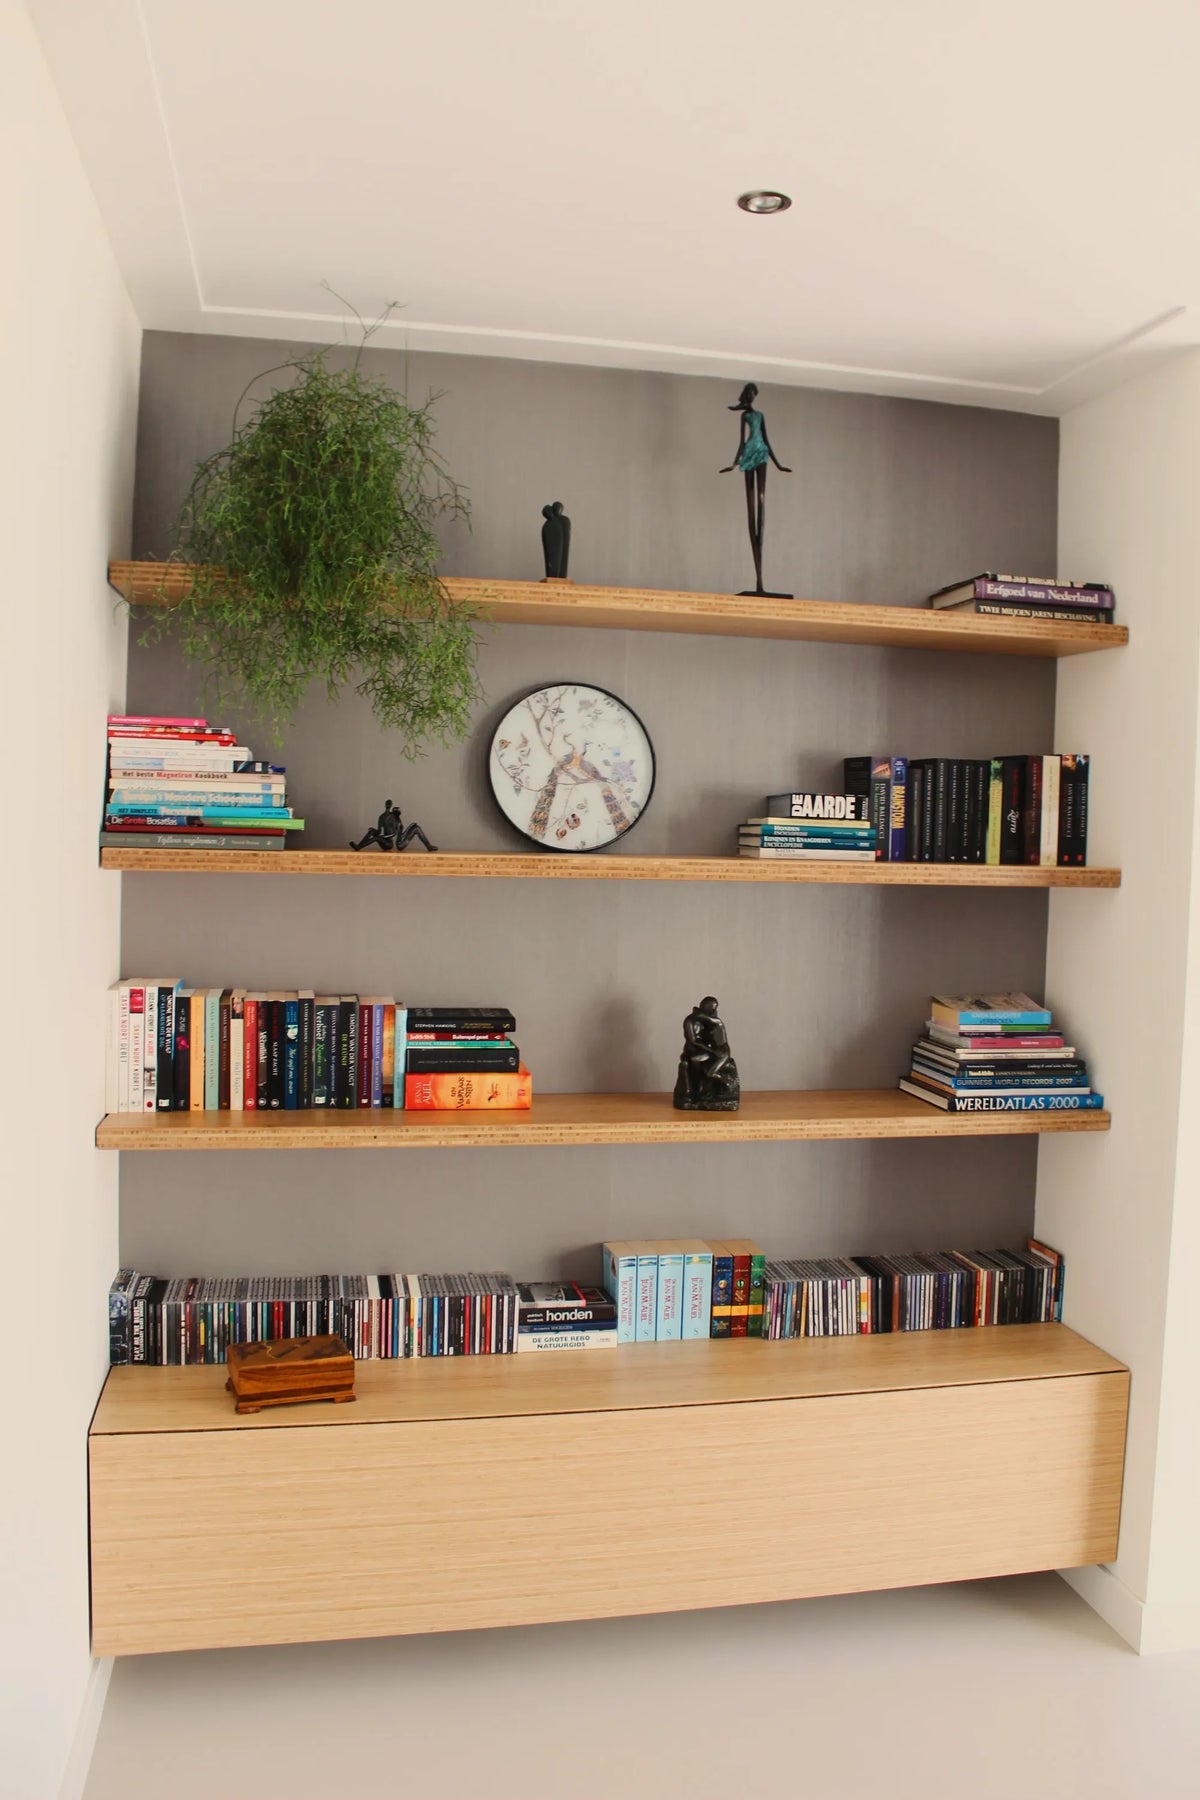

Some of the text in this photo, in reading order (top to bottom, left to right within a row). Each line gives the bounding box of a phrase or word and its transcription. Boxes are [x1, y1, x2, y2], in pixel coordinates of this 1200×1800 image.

[987, 584, 1098, 603] Erfgoed van Nederland
[1032, 610, 1053, 618] JAREN
[792, 795, 803, 816] DE
[800, 795, 855, 819] AARDE
[892, 786, 905, 829] BRAINSTORM
[112, 816, 122, 824] De
[146, 817, 177, 825] Bosatlas
[1007, 810, 1018, 833] Zorro
[120, 995, 128, 1017] SASKIA
[316, 1010, 324, 1041] Verhoef
[342, 1034, 347, 1042] DE
[423, 1082, 431, 1104] AUEL
[955, 1097, 1080, 1111] WERELDATLAS 2000
[546, 1309, 592, 1321] honden
[134, 1337, 140, 1345] ME
